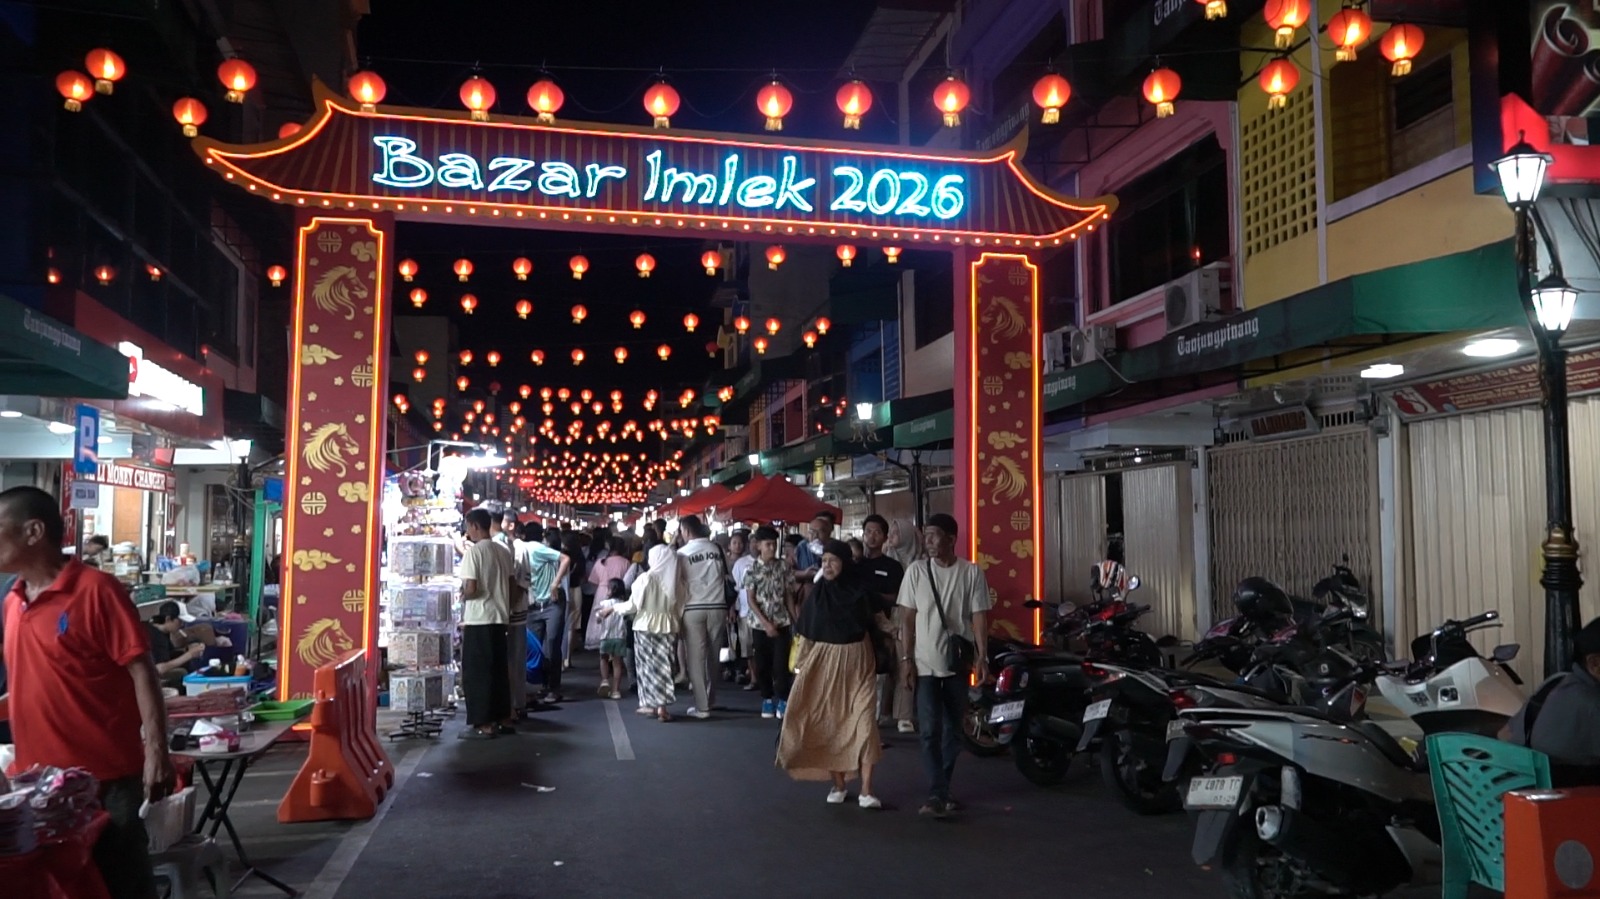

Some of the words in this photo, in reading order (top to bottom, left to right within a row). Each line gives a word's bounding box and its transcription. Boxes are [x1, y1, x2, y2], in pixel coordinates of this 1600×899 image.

[372, 136, 626, 198] Bazar
[644, 150, 816, 212] Imlek
[830, 166, 964, 219] 2026
[1177, 316, 1260, 356] Tanjungpinang
[107, 463, 134, 487] MONEY
[134, 468, 166, 491] CHANGER
